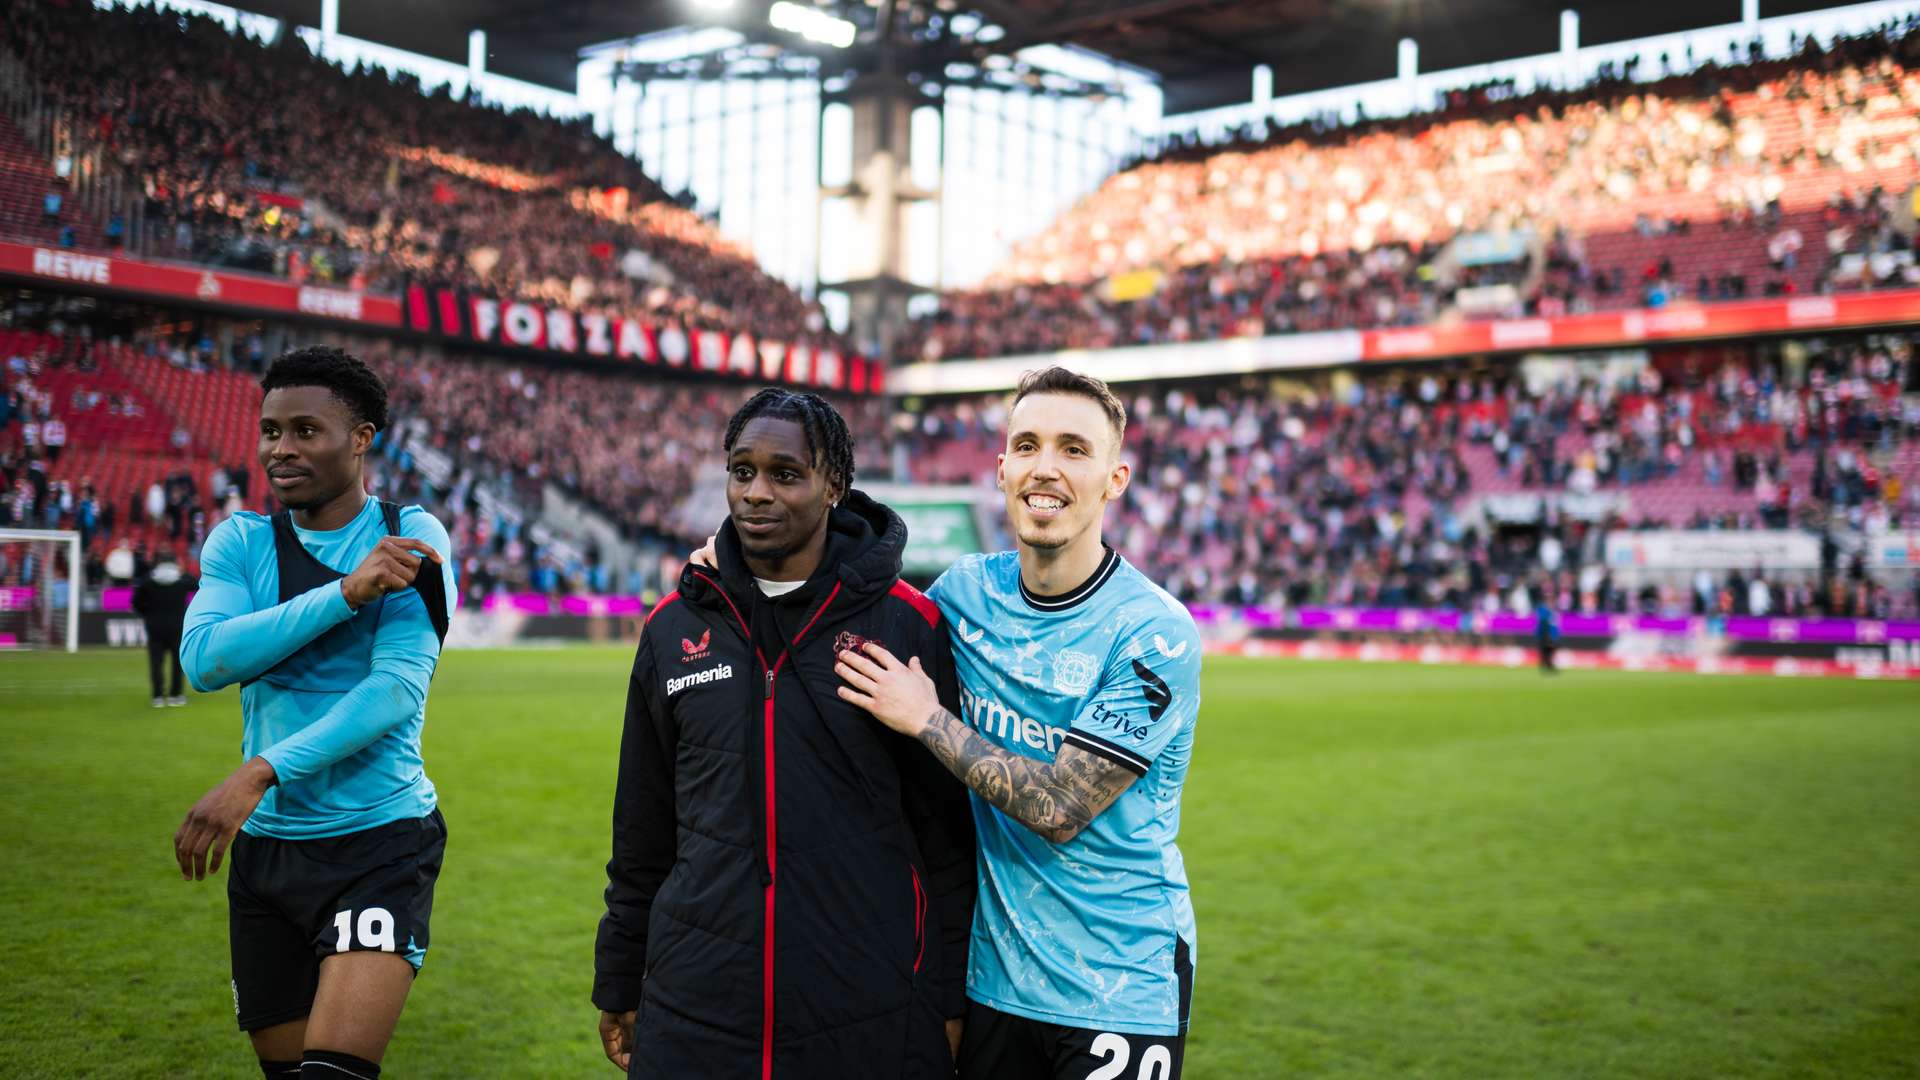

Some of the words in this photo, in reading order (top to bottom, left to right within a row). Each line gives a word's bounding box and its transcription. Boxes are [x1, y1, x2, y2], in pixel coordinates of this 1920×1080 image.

[34, 248, 111, 284] REWE
[477, 299, 654, 362] FORZA
[666, 663, 733, 696] Barmenia
[1091, 703, 1148, 740] trive
[333, 907, 395, 952] 19
[1085, 1032, 1171, 1080] 20
